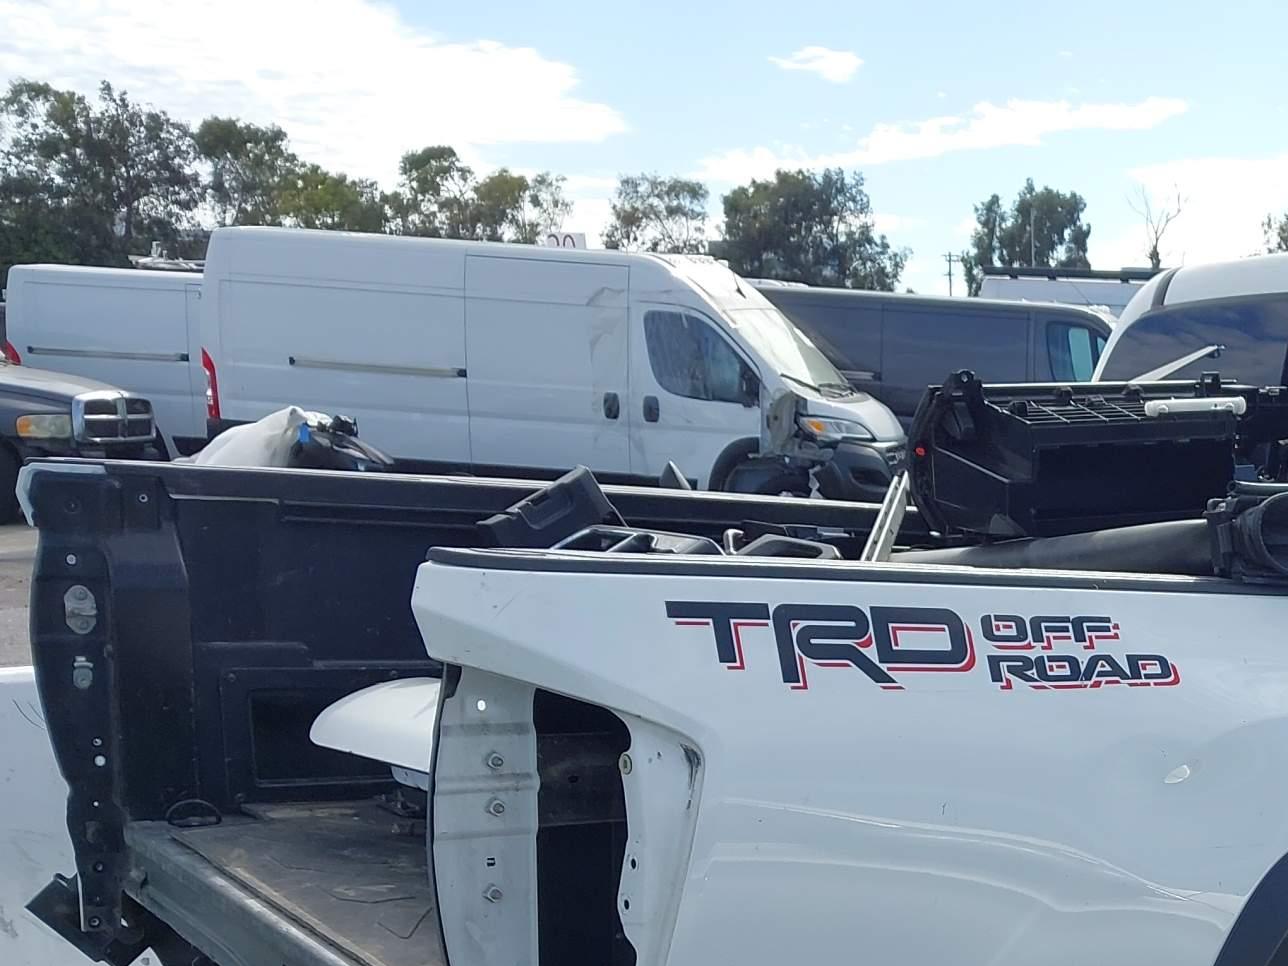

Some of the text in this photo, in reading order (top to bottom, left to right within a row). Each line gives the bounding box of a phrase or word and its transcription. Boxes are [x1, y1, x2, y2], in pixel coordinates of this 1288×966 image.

[665, 600, 1120, 690] TRD OFF
[986, 653, 1181, 690] ROAD
